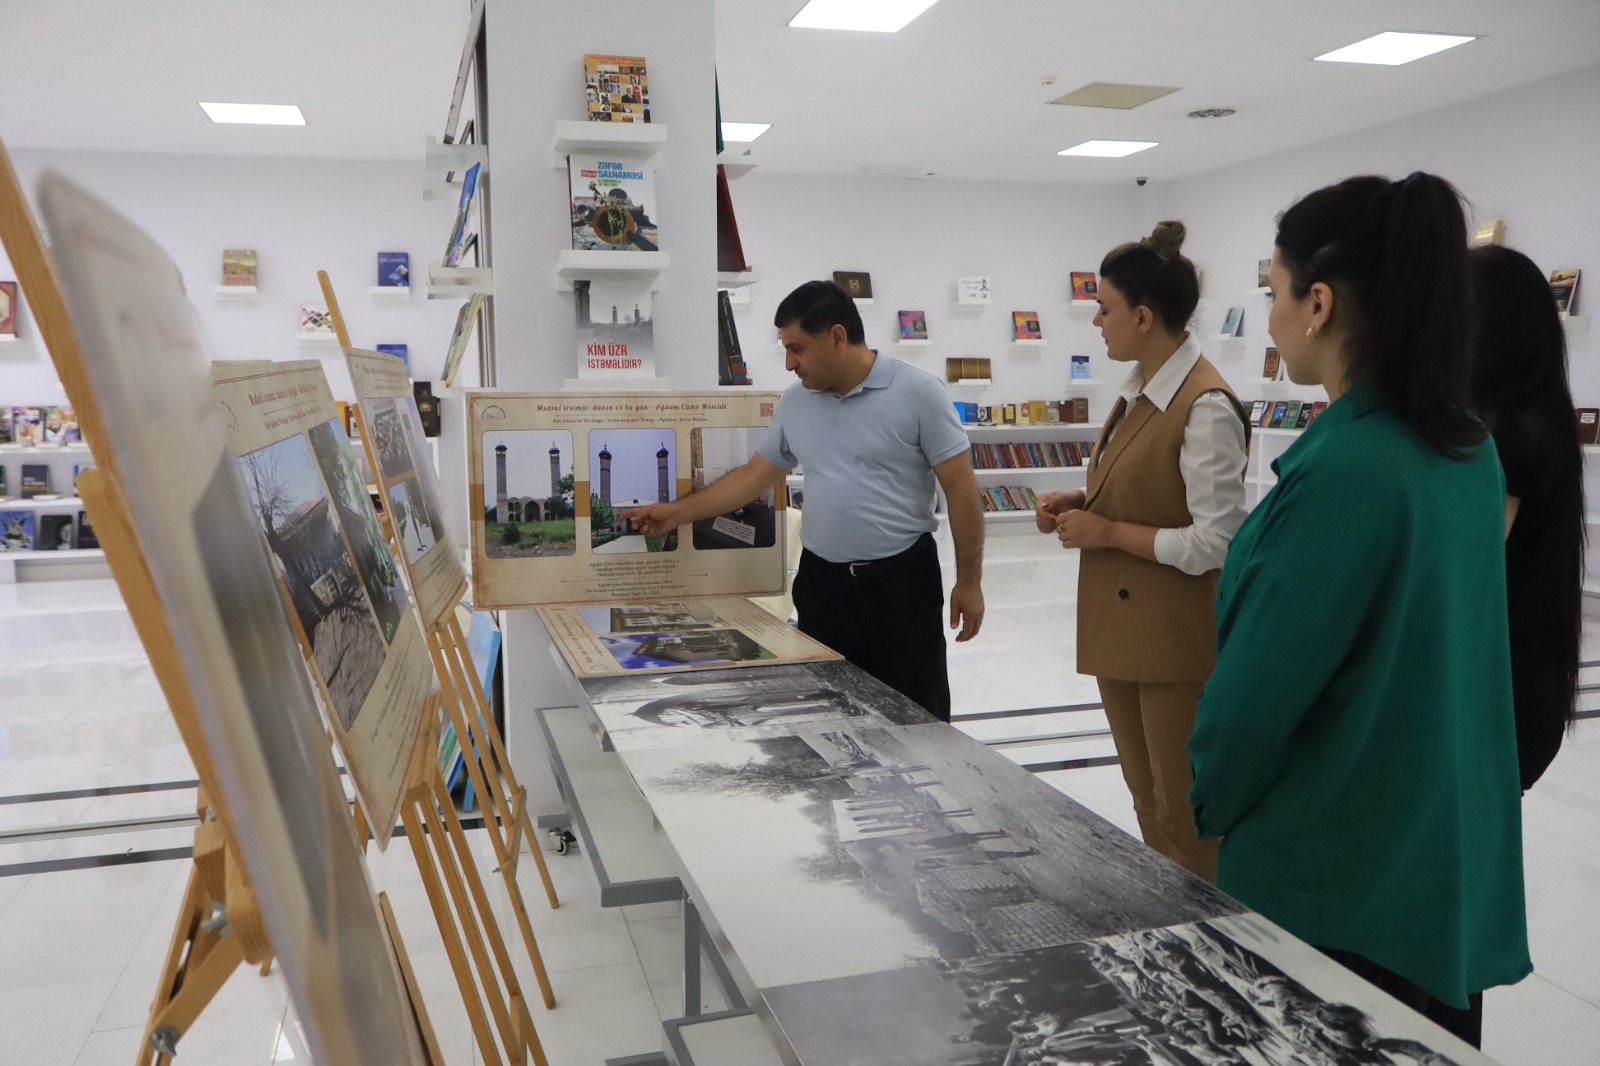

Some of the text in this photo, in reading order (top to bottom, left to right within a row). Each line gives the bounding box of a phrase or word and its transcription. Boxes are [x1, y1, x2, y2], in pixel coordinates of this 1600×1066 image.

[598, 170, 643, 180] SALNAMƏSİ
[587, 342, 628, 356] KİM ÜZR
[588, 358, 642, 369] İSTƏMƏLİDİR?
